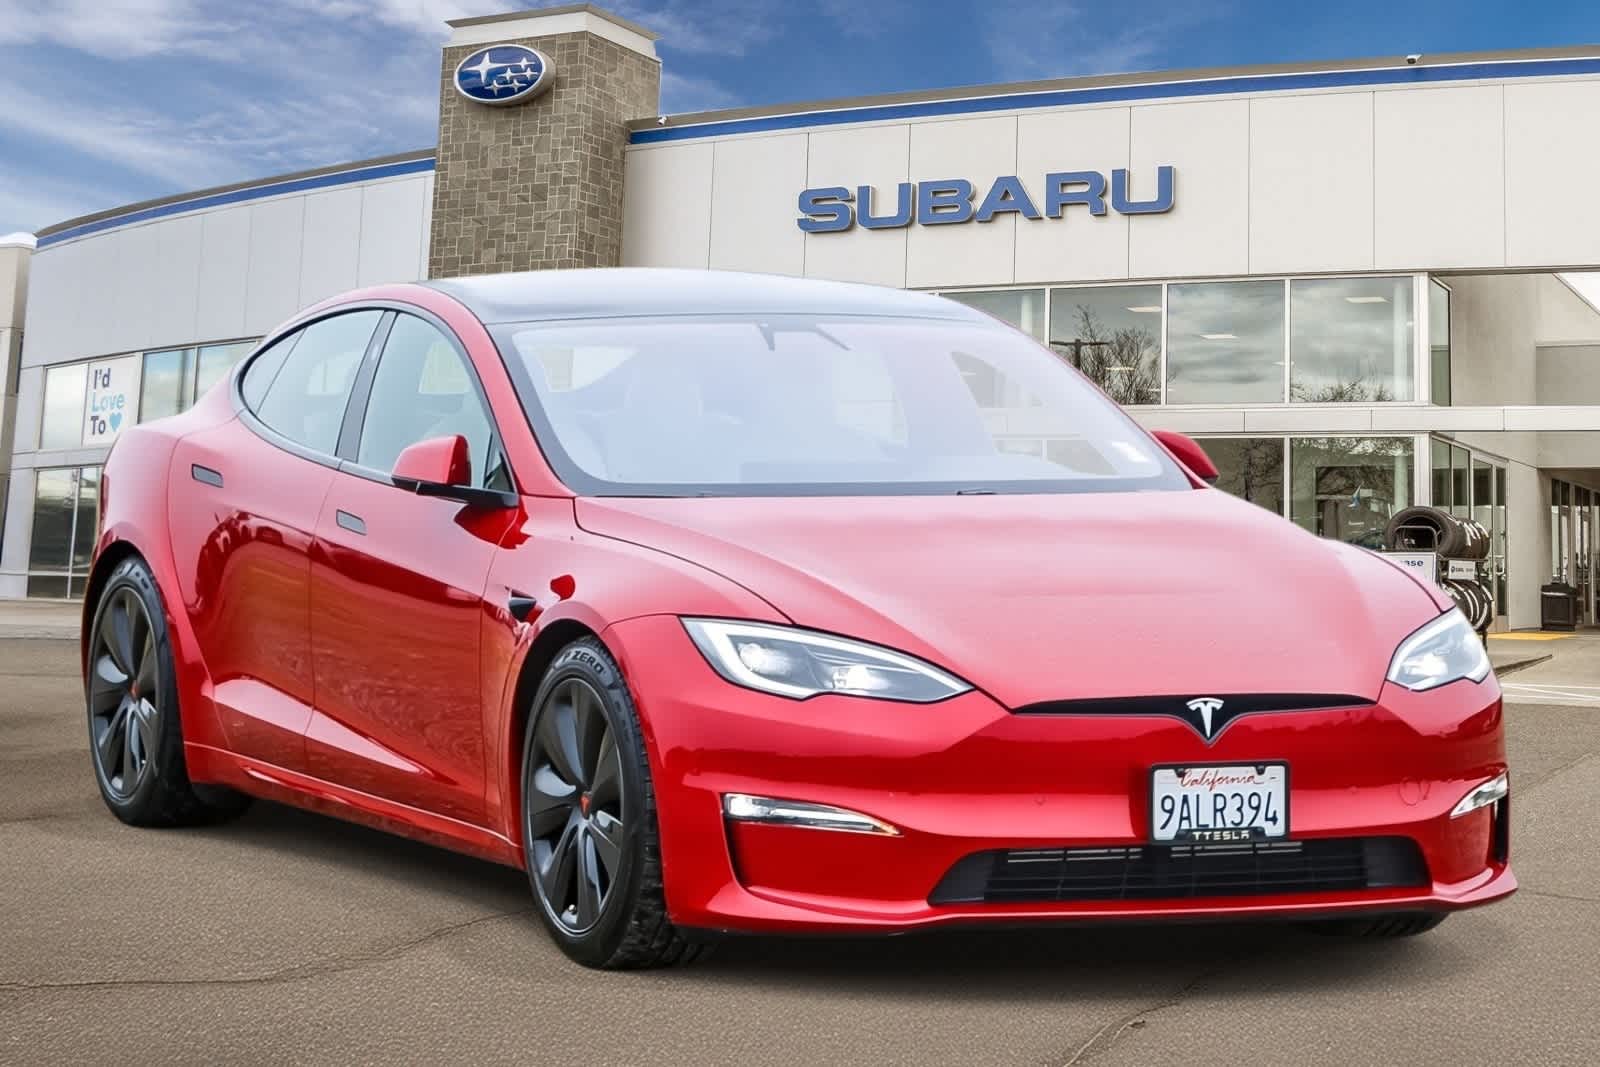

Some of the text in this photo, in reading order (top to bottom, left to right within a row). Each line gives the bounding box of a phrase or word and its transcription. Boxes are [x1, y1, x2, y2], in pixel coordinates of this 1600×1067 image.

[797, 165, 1176, 233] SUBARU
[91, 391, 125, 412] Love
[90, 415, 106, 435] To
[572, 650, 604, 674] ZERO
[1181, 768, 1264, 791] California
[1160, 791, 1278, 830] 9ALR394
